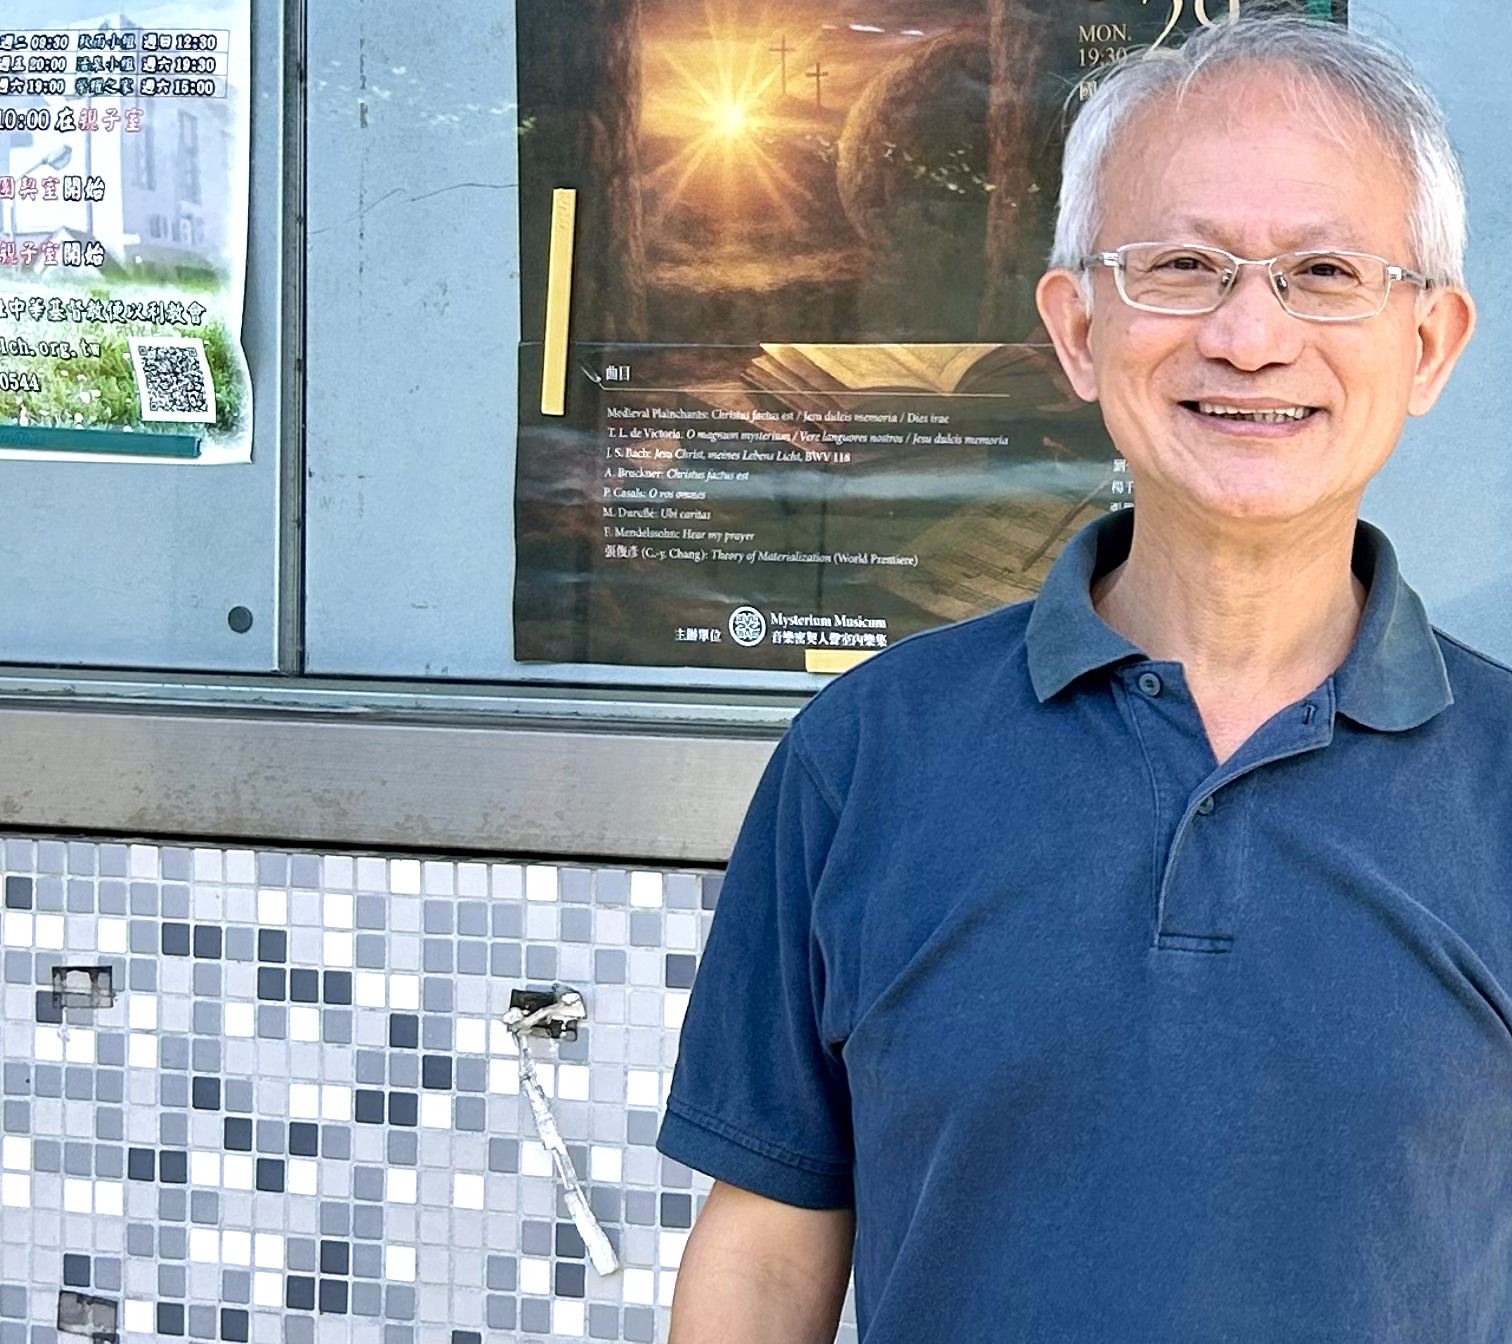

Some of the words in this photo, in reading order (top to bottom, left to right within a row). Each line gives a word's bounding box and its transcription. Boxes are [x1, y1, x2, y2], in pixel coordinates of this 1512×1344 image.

[1078, 24, 1132, 42] MON.
[606, 365, 630, 381] 曲目
[607, 407, 649, 419] Medieval
[965, 435, 1009, 446] memoria
[805, 452, 831, 462] BWV
[770, 612, 832, 628] Mysterium
[834, 614, 887, 629] Musicum
